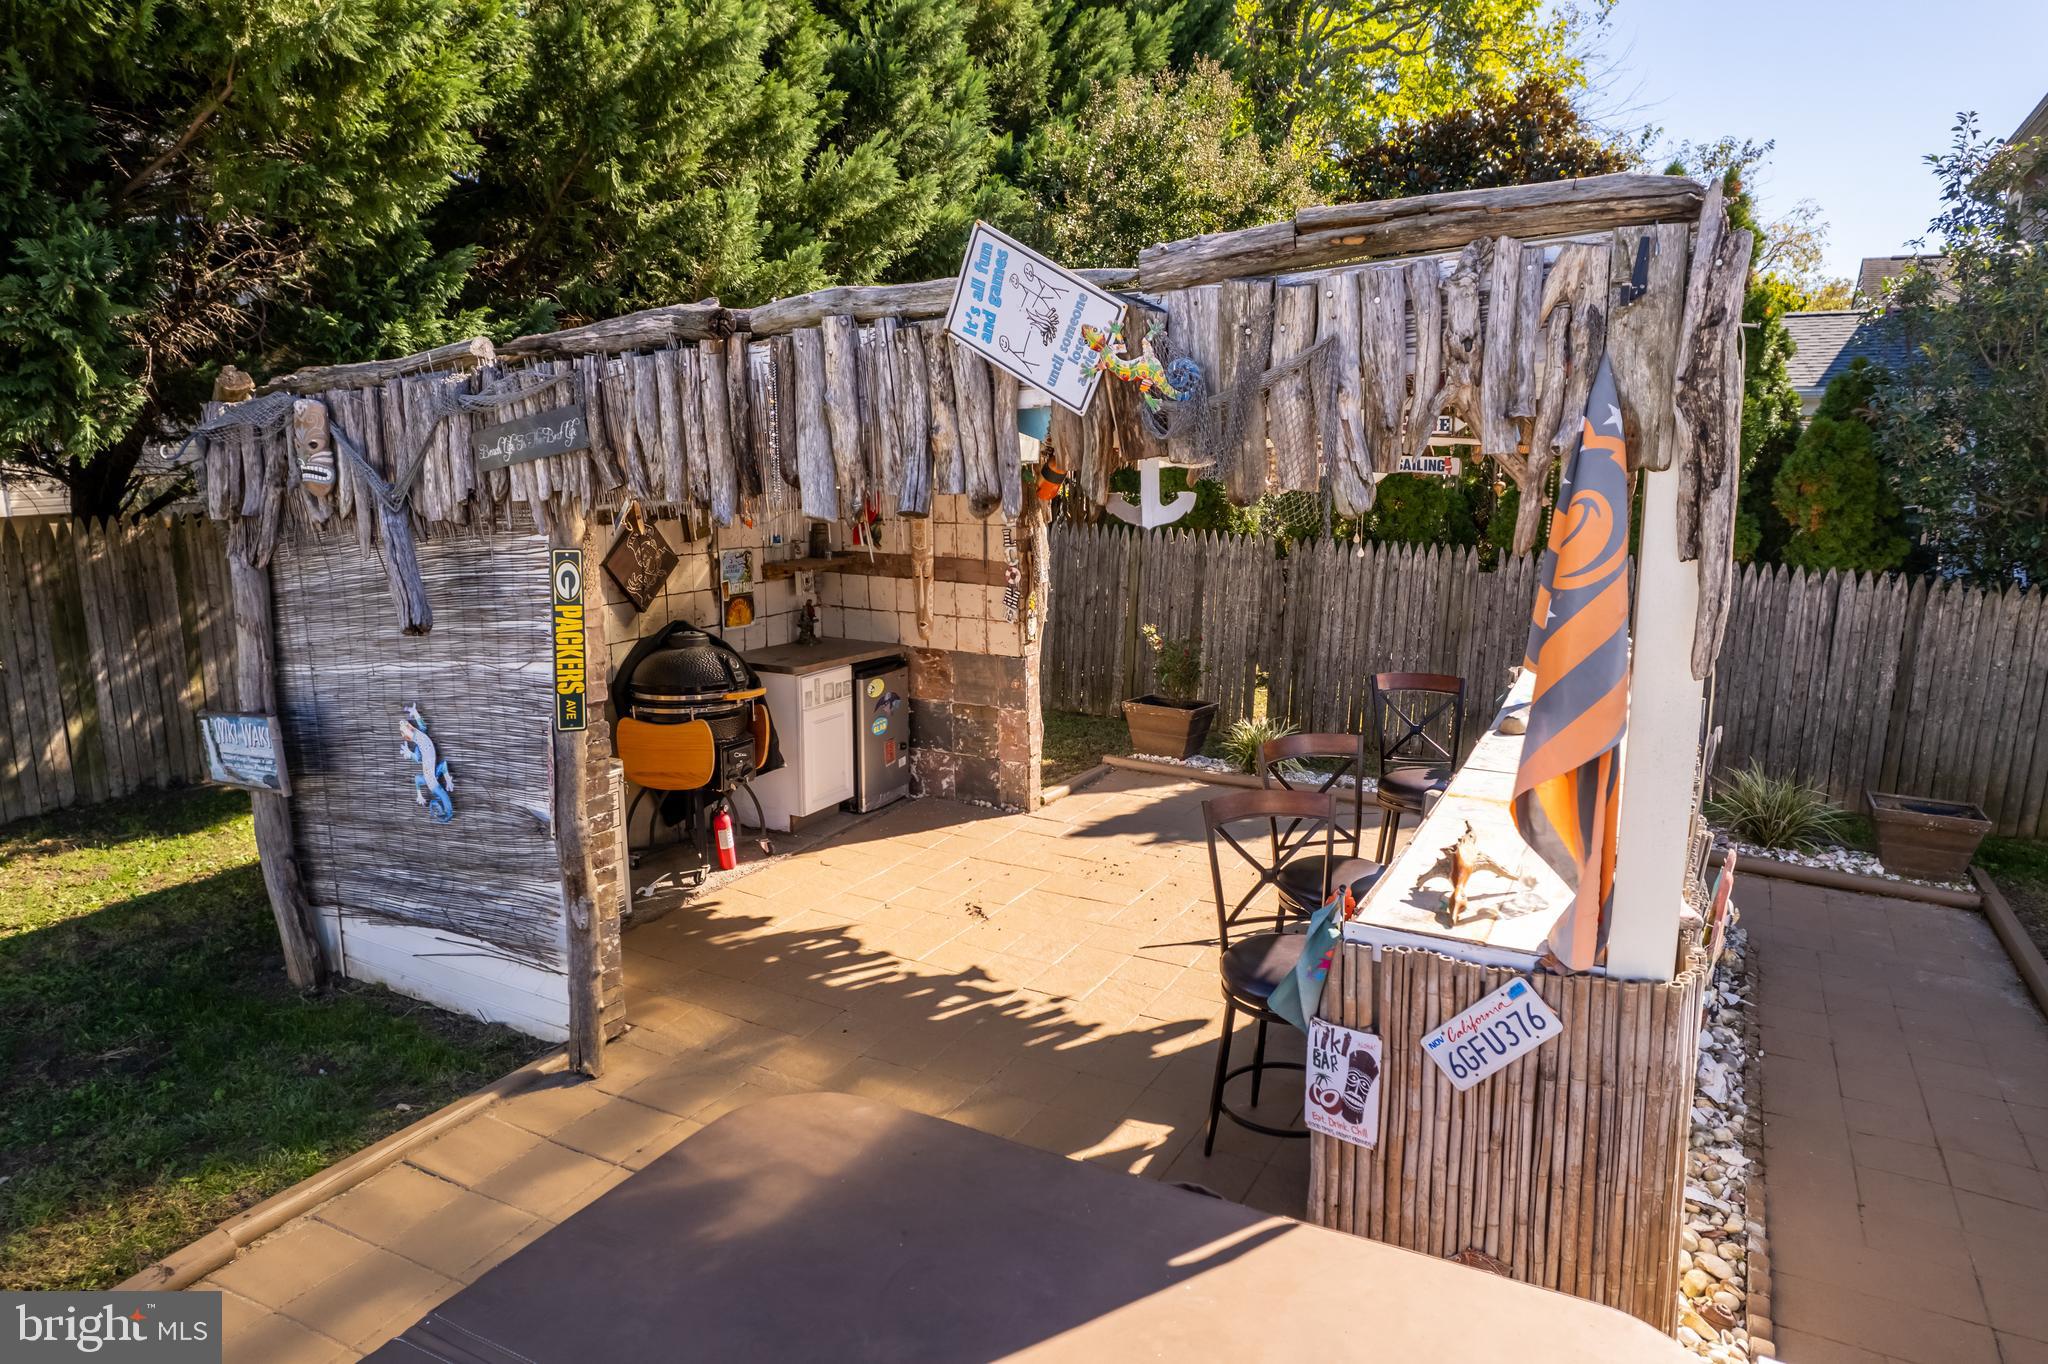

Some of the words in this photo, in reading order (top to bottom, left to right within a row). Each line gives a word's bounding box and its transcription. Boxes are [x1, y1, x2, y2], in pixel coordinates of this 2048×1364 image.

[974, 241, 993, 275] fun
[970, 277, 985, 302] all
[981, 308, 997, 344] and
[989, 248, 1009, 309] games
[962, 305, 981, 337] It's
[1047, 354, 1065, 388] until
[1062, 293, 1089, 352] someone
[1068, 336, 1086, 365] lose
[554, 605, 585, 695] PACKERS
[565, 699, 577, 720] AVE
[1428, 1035, 1445, 1050] NOV
[1447, 1000, 1513, 1043] California
[1448, 1002, 1547, 1079] 6GFU376
[1313, 1048, 1339, 1073] BAR
